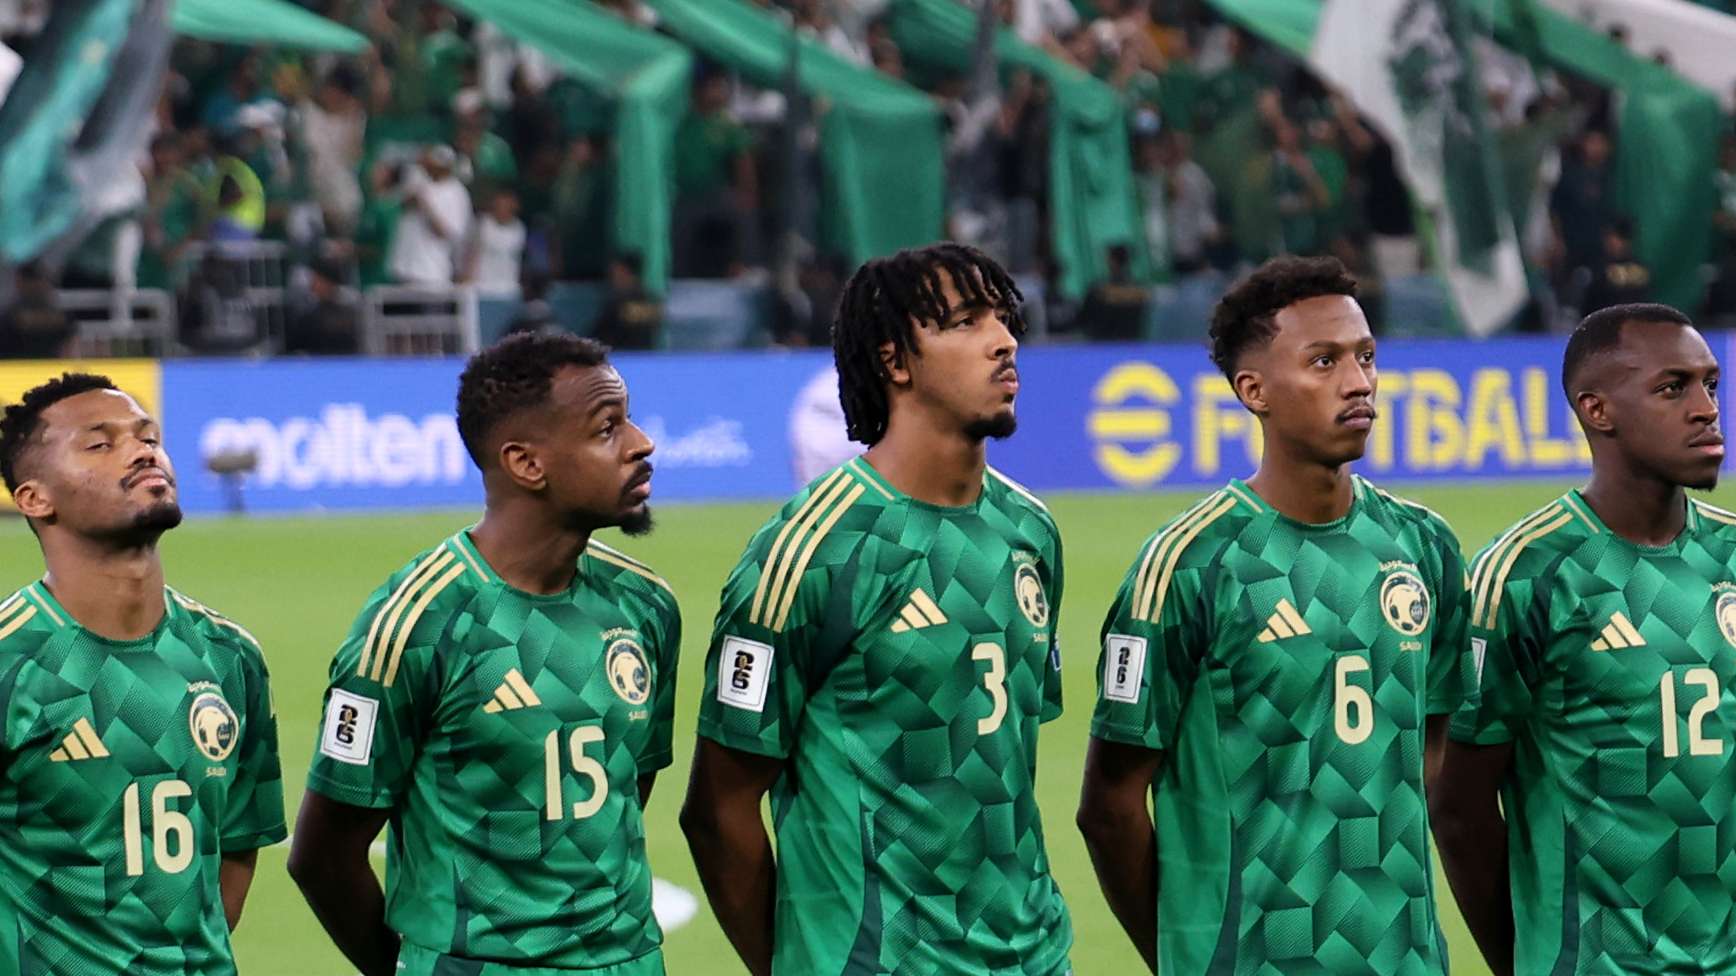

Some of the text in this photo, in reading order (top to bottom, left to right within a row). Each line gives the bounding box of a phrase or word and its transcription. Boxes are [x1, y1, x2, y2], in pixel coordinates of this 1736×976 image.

[202, 402, 467, 489] molten
[971, 642, 1008, 735] 3
[1333, 655, 1374, 745] 6
[1660, 668, 1724, 757] 12
[544, 725, 609, 820] 15
[123, 780, 195, 876] 16
